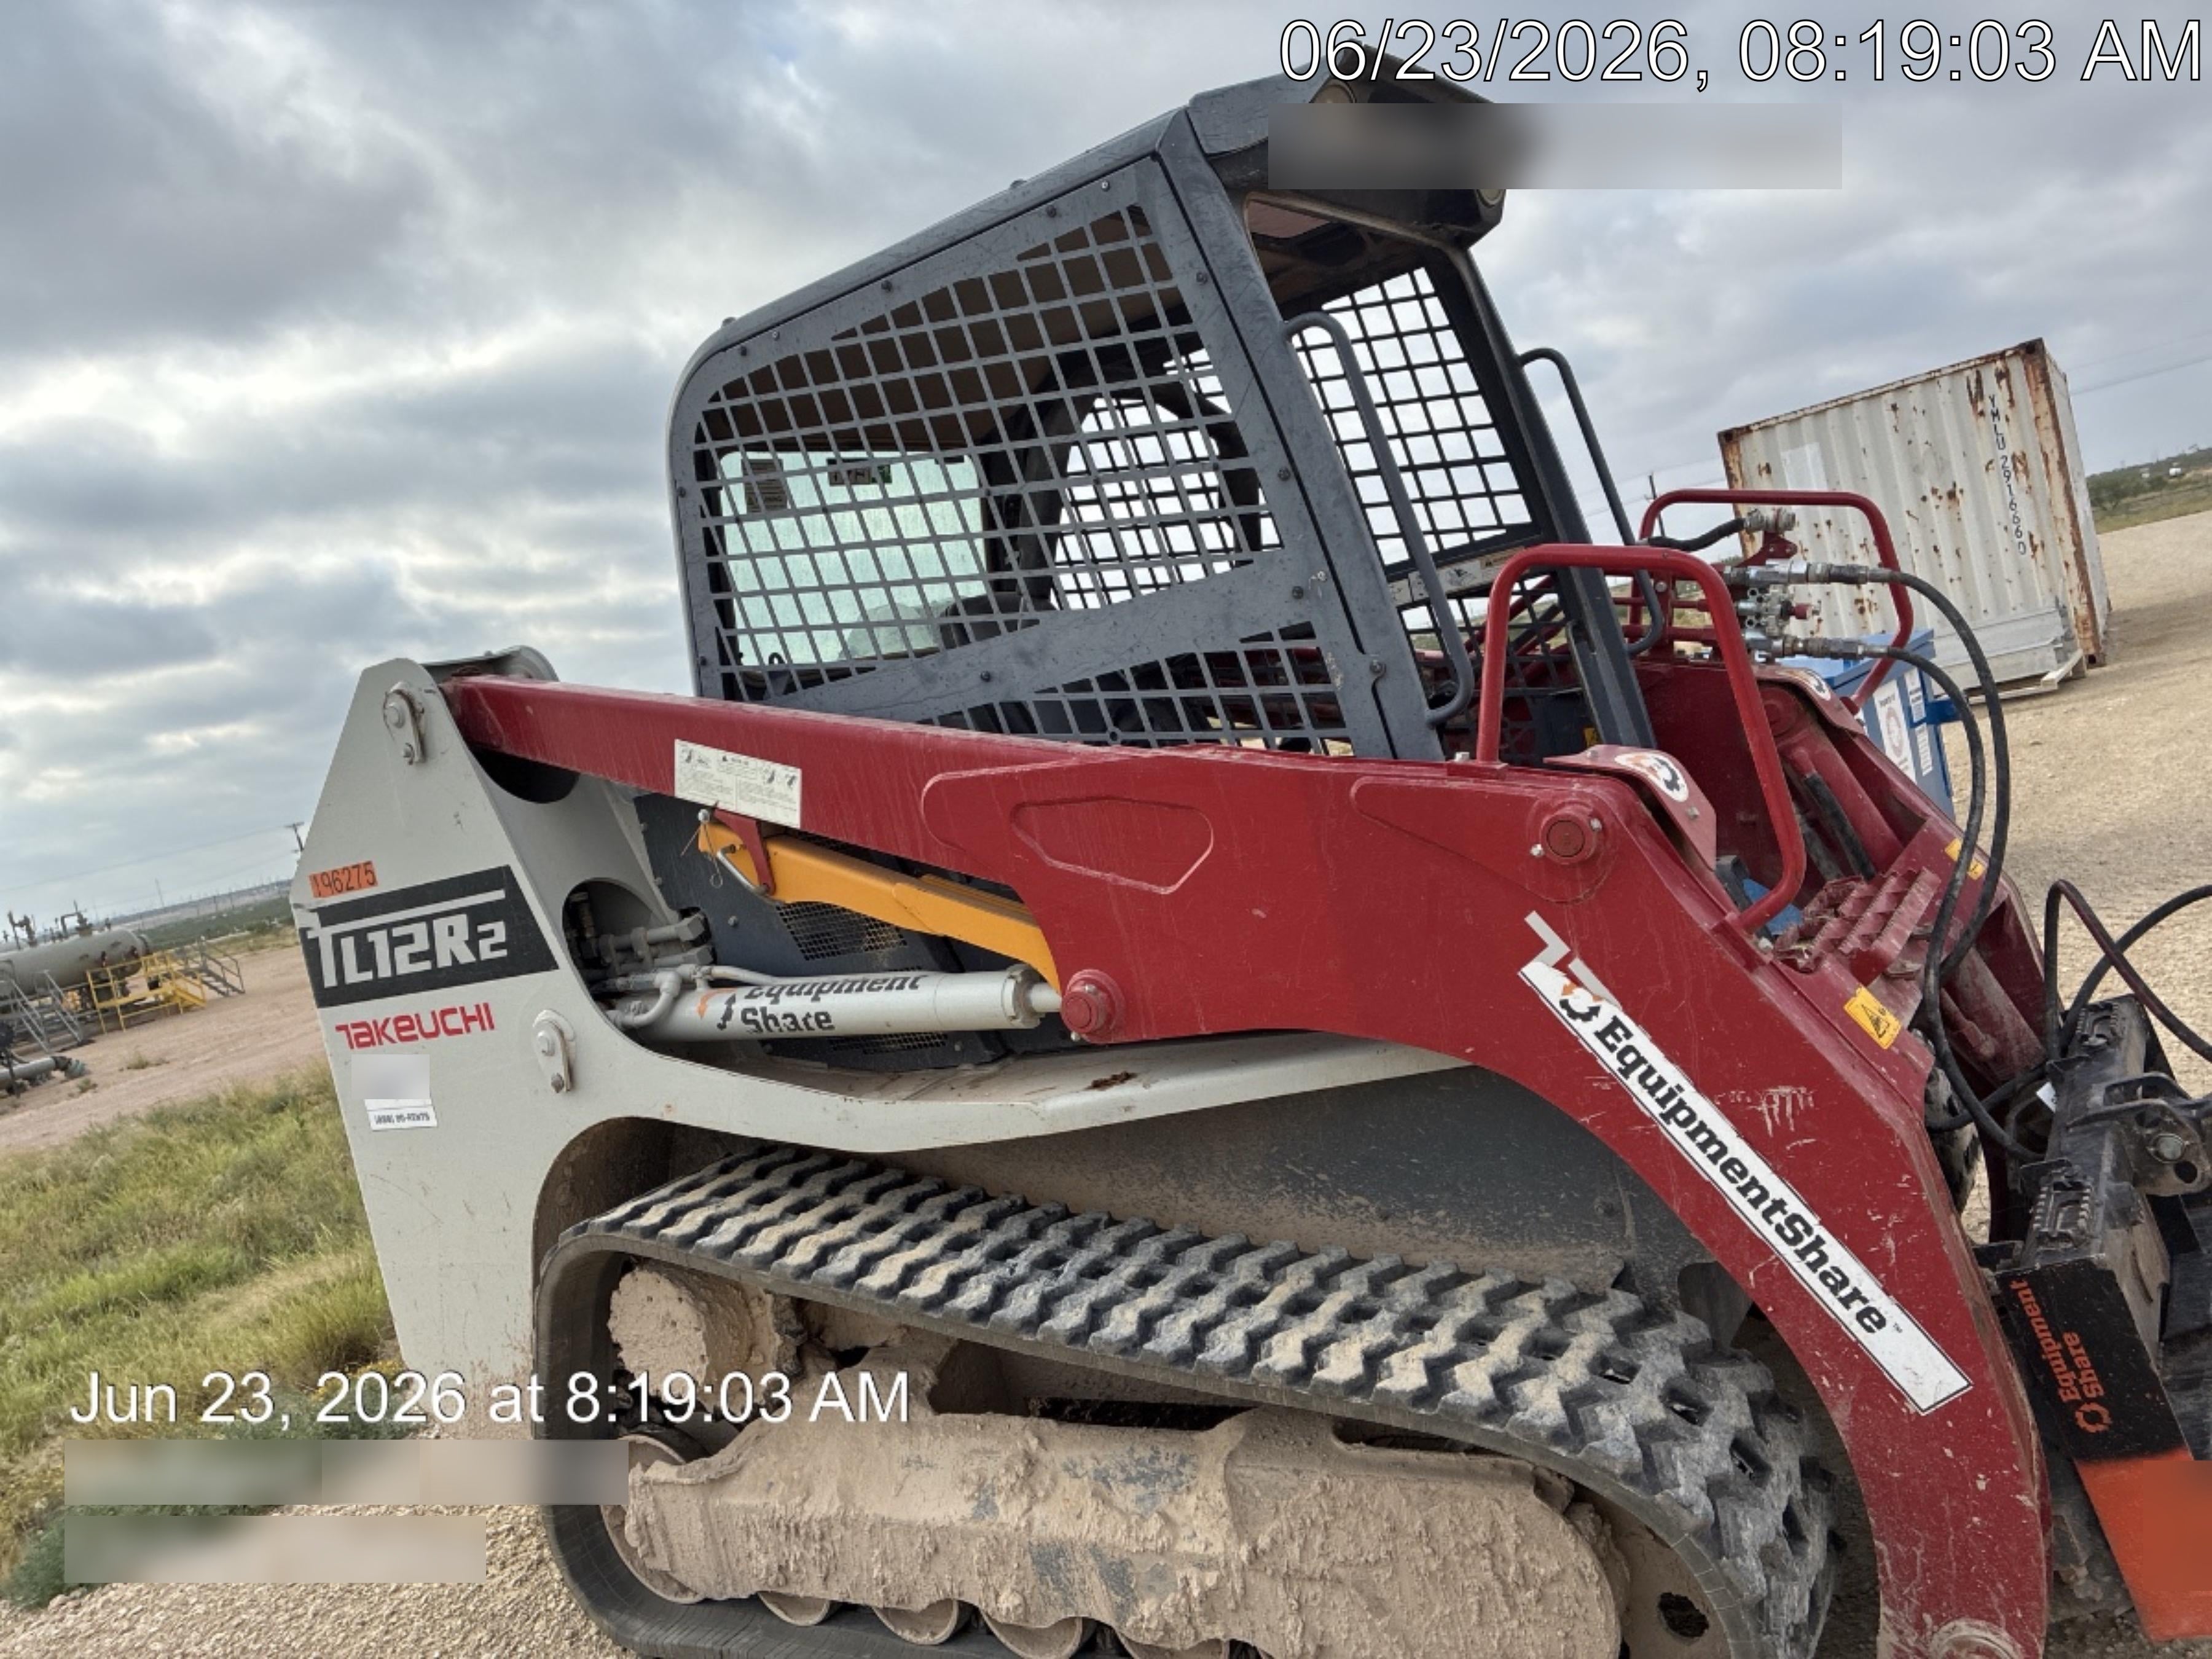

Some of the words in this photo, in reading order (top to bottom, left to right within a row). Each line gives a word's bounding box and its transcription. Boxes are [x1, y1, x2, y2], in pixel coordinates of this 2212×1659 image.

[1989, 394, 2006, 450] YMLU
[312, 861, 378, 897] 196275
[740, 1006, 835, 1033] Share
[1594, 1015, 1886, 1335] EquipmentShare
[2010, 1280, 2082, 1402] Equipment
[2063, 1331, 2104, 1398] Share
